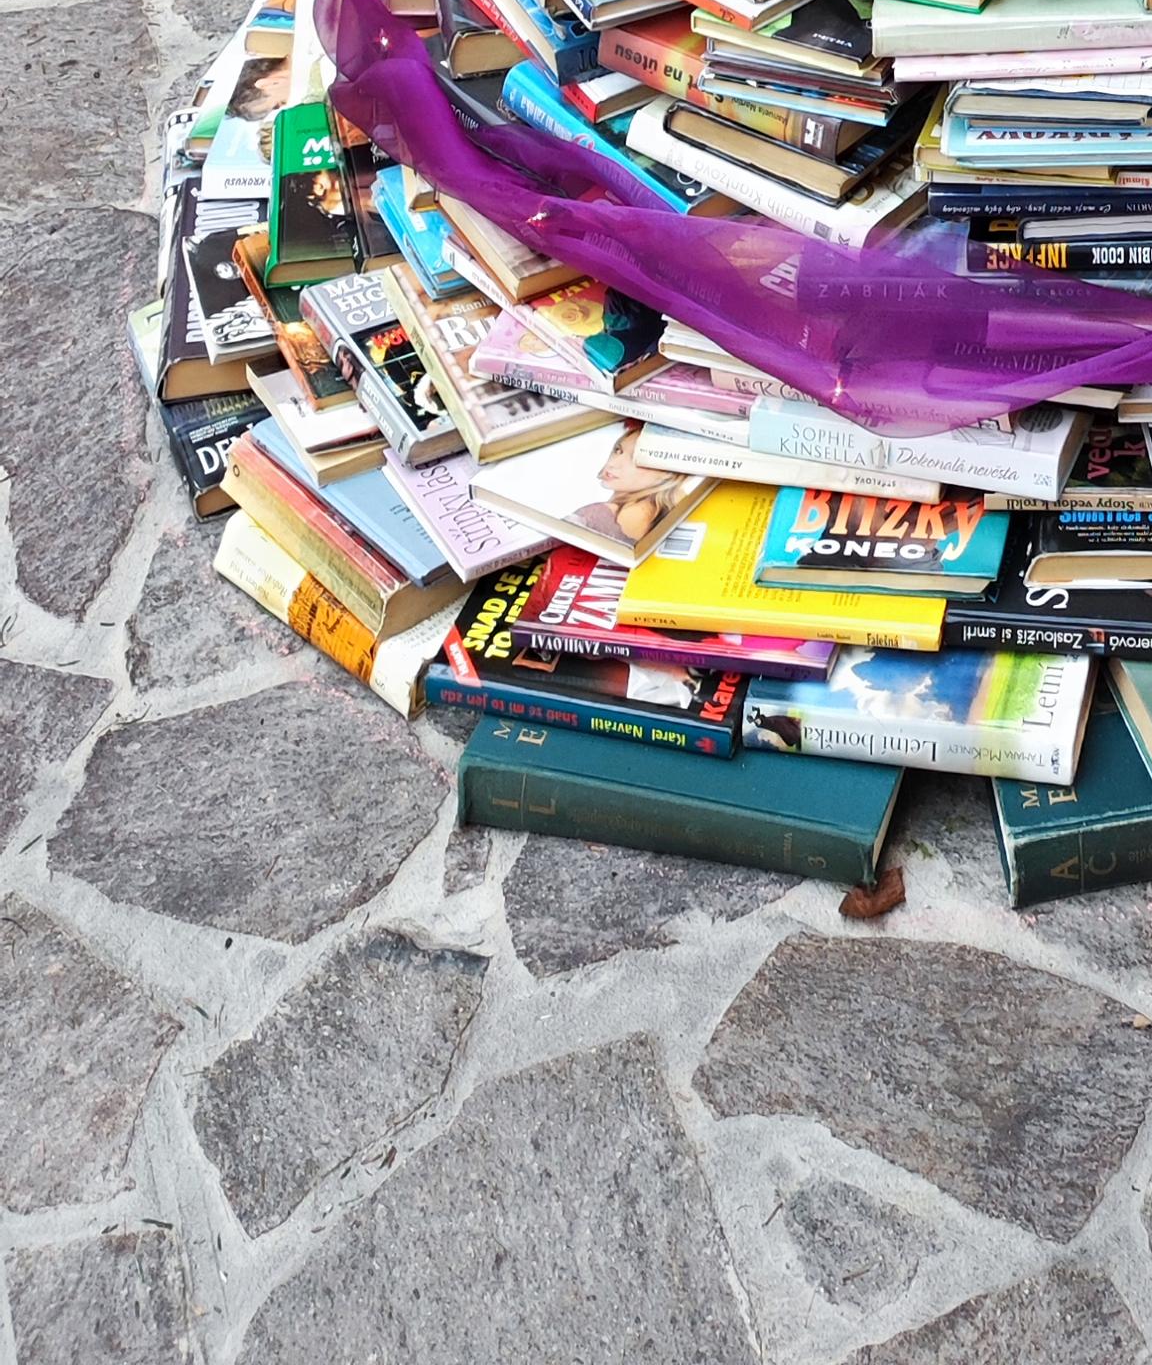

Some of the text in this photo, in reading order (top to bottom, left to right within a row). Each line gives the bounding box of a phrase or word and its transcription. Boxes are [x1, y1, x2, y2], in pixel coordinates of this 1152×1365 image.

[614, 42, 685, 84] na útesu
[1091, 247, 1125, 264] COOK
[819, 281, 949, 300] ZABIJÁK
[779, 438, 866, 467] KINSELLA
[1096, 498, 1134, 512] Stopy
[784, 538, 929, 561] KONEC
[530, 635, 600, 654] ZAMILOVAT
[1001, 629, 1011, 645] si
[1015, 627, 1083, 649] Zasloužíš
[591, 718, 686, 746] Karel Navrátil
[803, 725, 938, 762] Letní bouřka
